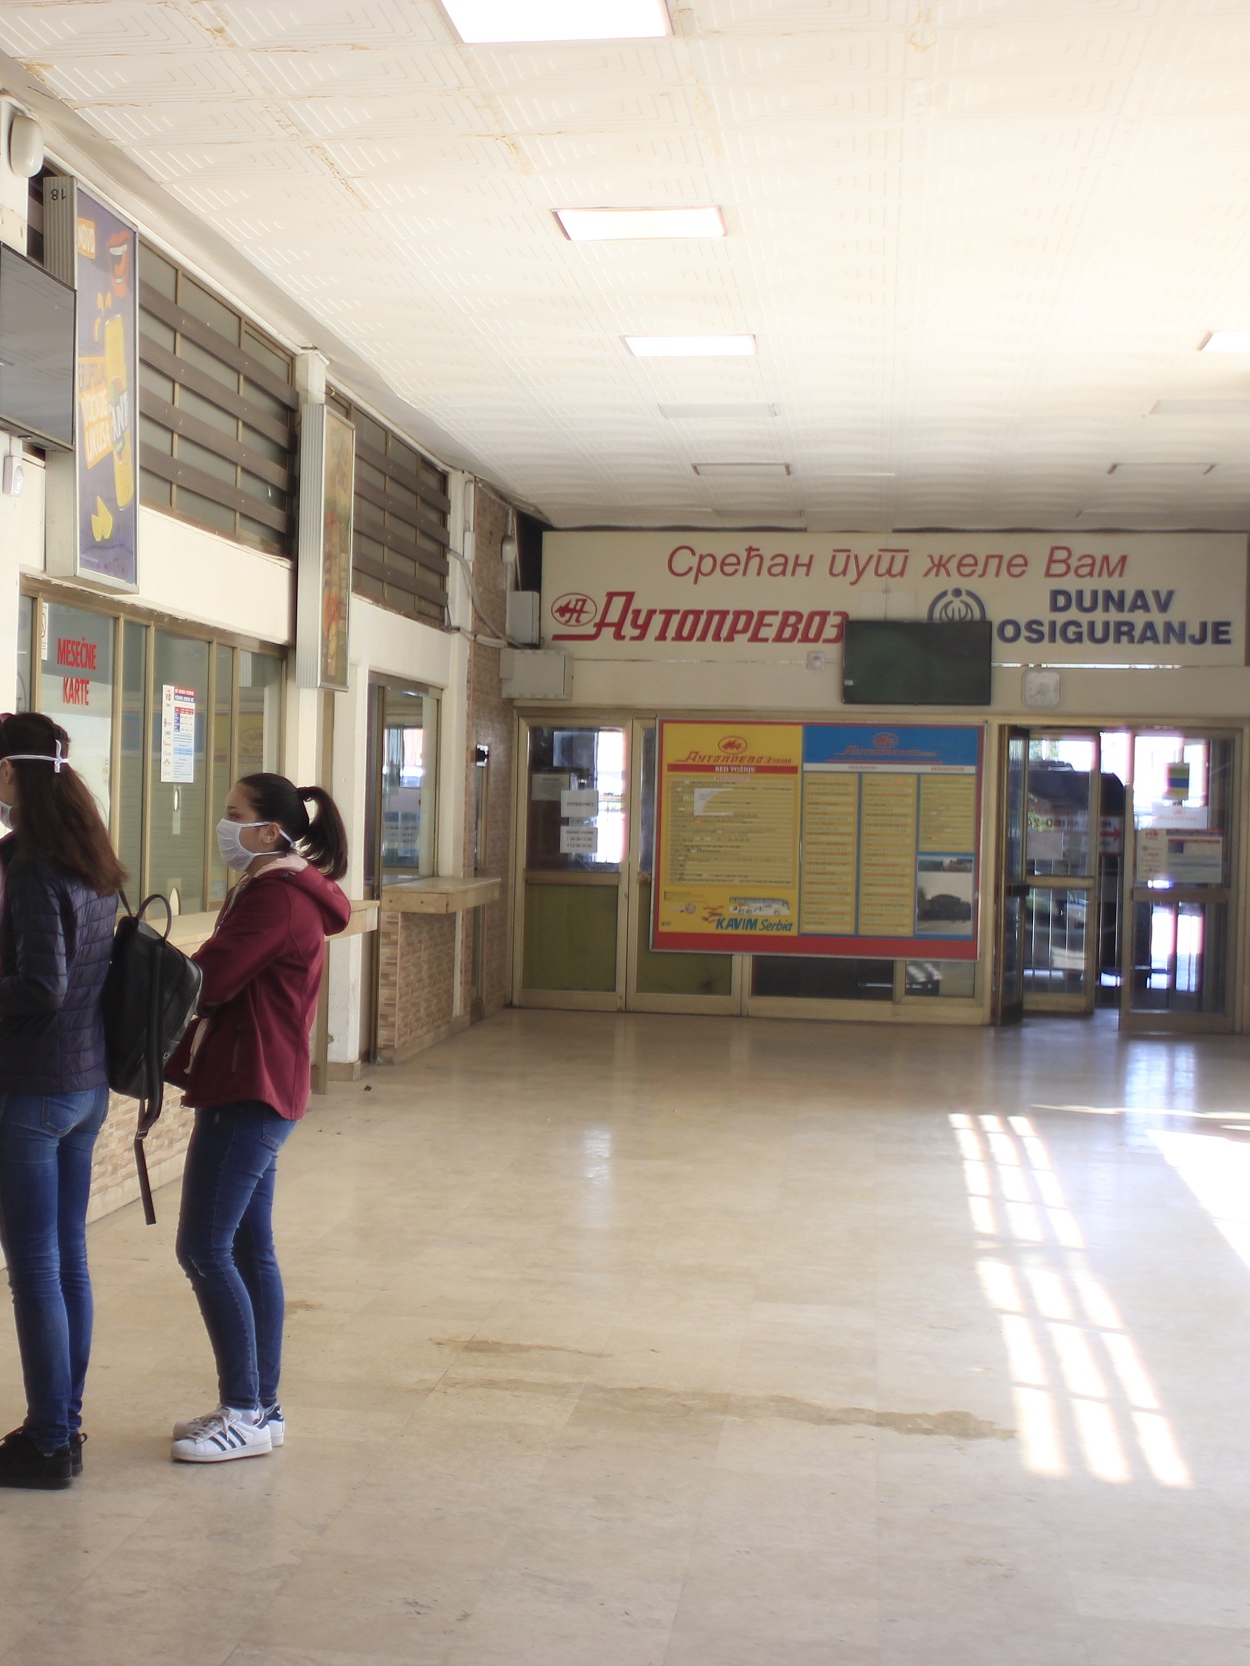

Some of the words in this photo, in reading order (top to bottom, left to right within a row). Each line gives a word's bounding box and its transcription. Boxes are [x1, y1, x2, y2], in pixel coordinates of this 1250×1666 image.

[667, 545, 814, 585] Срећан
[923, 553, 1029, 578] желе
[1044, 545, 1128, 578] Вам
[1049, 589, 1175, 614] DUNAV
[996, 619, 1232, 645] OSIGURANJE
[63, 676, 90, 706] KARTE
[715, 917, 758, 930] KAVIM
[759, 919, 793, 931] Serbia
